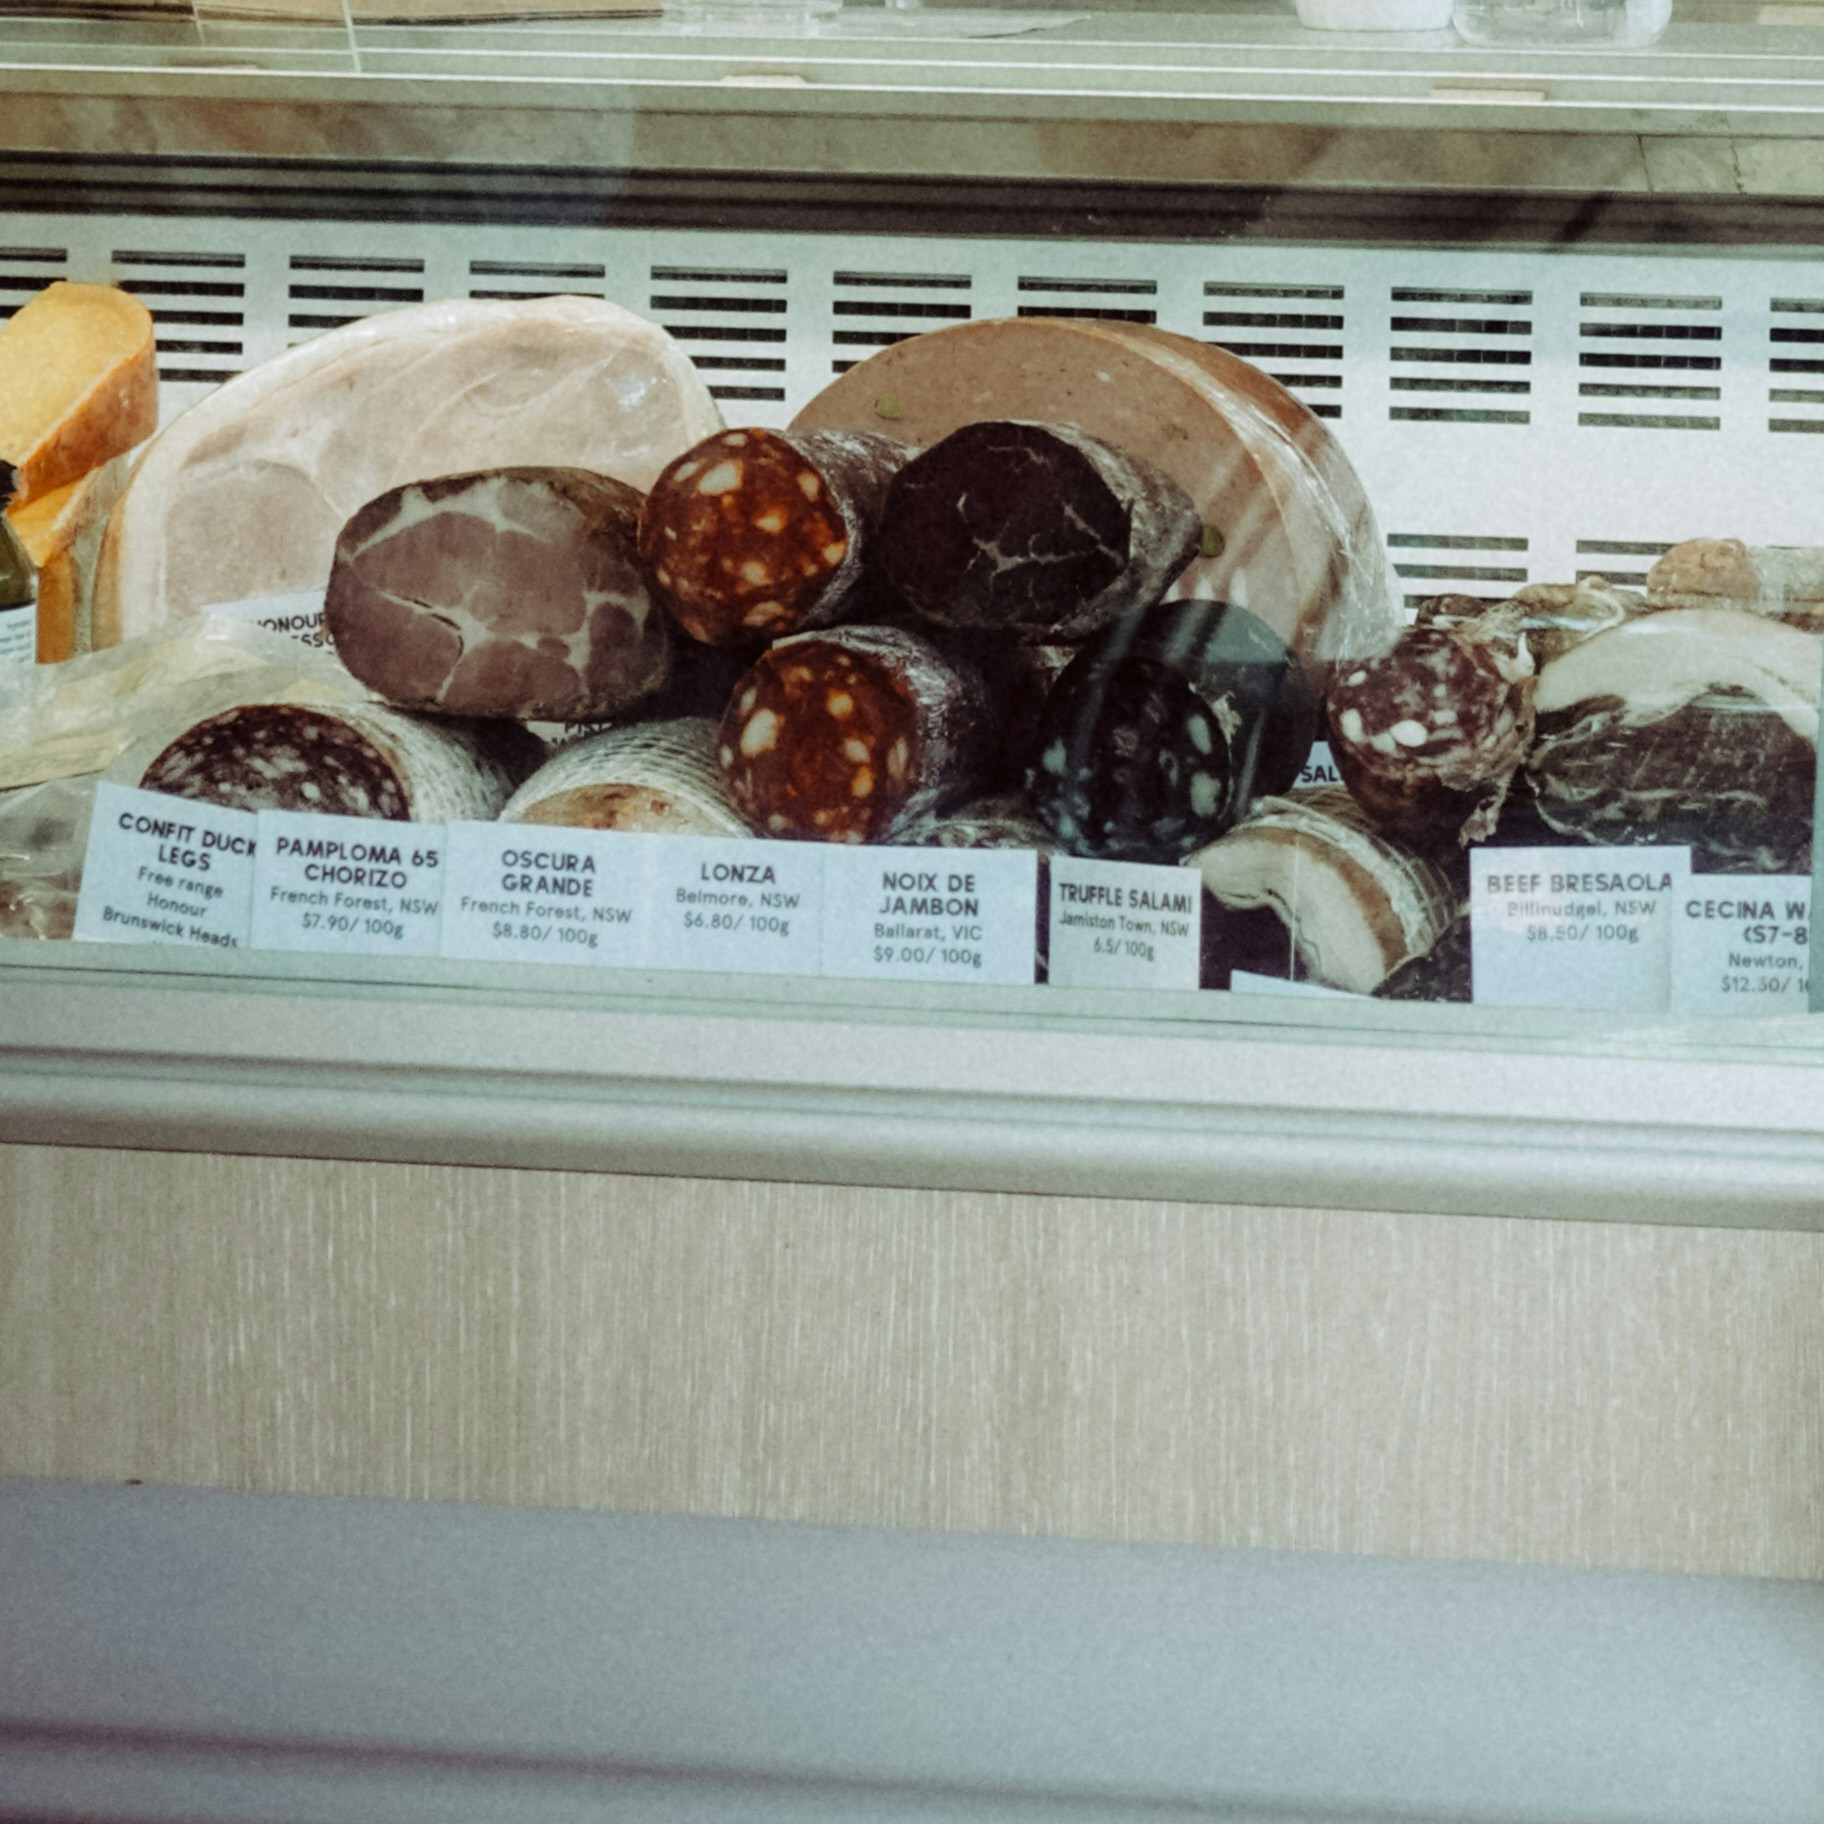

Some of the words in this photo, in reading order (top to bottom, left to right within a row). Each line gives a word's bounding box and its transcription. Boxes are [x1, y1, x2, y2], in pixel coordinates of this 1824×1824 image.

[118, 812, 196, 843] CONFIT
[201, 829, 258, 857] DUCK
[157, 844, 212, 872] LEGS
[276, 837, 401, 865] PAMPLOMA
[411, 849, 439, 868] 65
[501, 849, 597, 874] OSCURA
[137, 865, 174, 887] Free
[178, 877, 224, 900] range
[304, 862, 408, 890] CHORIZO
[501, 873, 593, 898] GRANDE
[701, 862, 776, 884] LONZA
[882, 872, 937, 891] NOIX
[948, 873, 976, 893] DE
[1486, 873, 1541, 895] BEEF
[1550, 872, 1673, 893] BRESAOLA
[146, 891, 208, 918] Honour
[269, 886, 329, 906] French
[334, 891, 393, 913] Forest,
[400, 898, 438, 916] NSW
[460, 895, 520, 917] French
[525, 900, 586, 923] Forest,
[592, 906, 633, 923] NSW
[675, 887, 753, 908] Belmore,
[760, 892, 801, 909] NSW
[878, 897, 980, 917] JAMBON
[1058, 882, 1123, 907] TRUFFLE
[1128, 889, 1193, 914] SALAMI
[1615, 899, 1657, 916] NSW
[1685, 900, 1775, 919] CECINA
[102, 905, 185, 938] Brunswick
[302, 912, 360, 932] $7.90/
[365, 918, 405, 940] 100g
[683, 911, 745, 931] $6.80/
[749, 915, 790, 937] 100g
[873, 922, 947, 942] Ballarat,
[951, 924, 983, 941] VIC
[1118, 915, 1156, 936] Town,
[1160, 921, 1190, 938] NSW
[1596, 923, 1640, 944] 100g
[492, 920, 553, 942] $8.80/
[557, 927, 599, 950] 100g
[873, 946, 936, 964] $9.00/
[940, 947, 982, 969] 100g
[1093, 937, 1122, 954] 6.5/
[1125, 940, 1155, 962] 100g
[1728, 952, 1804, 971] Newton,
